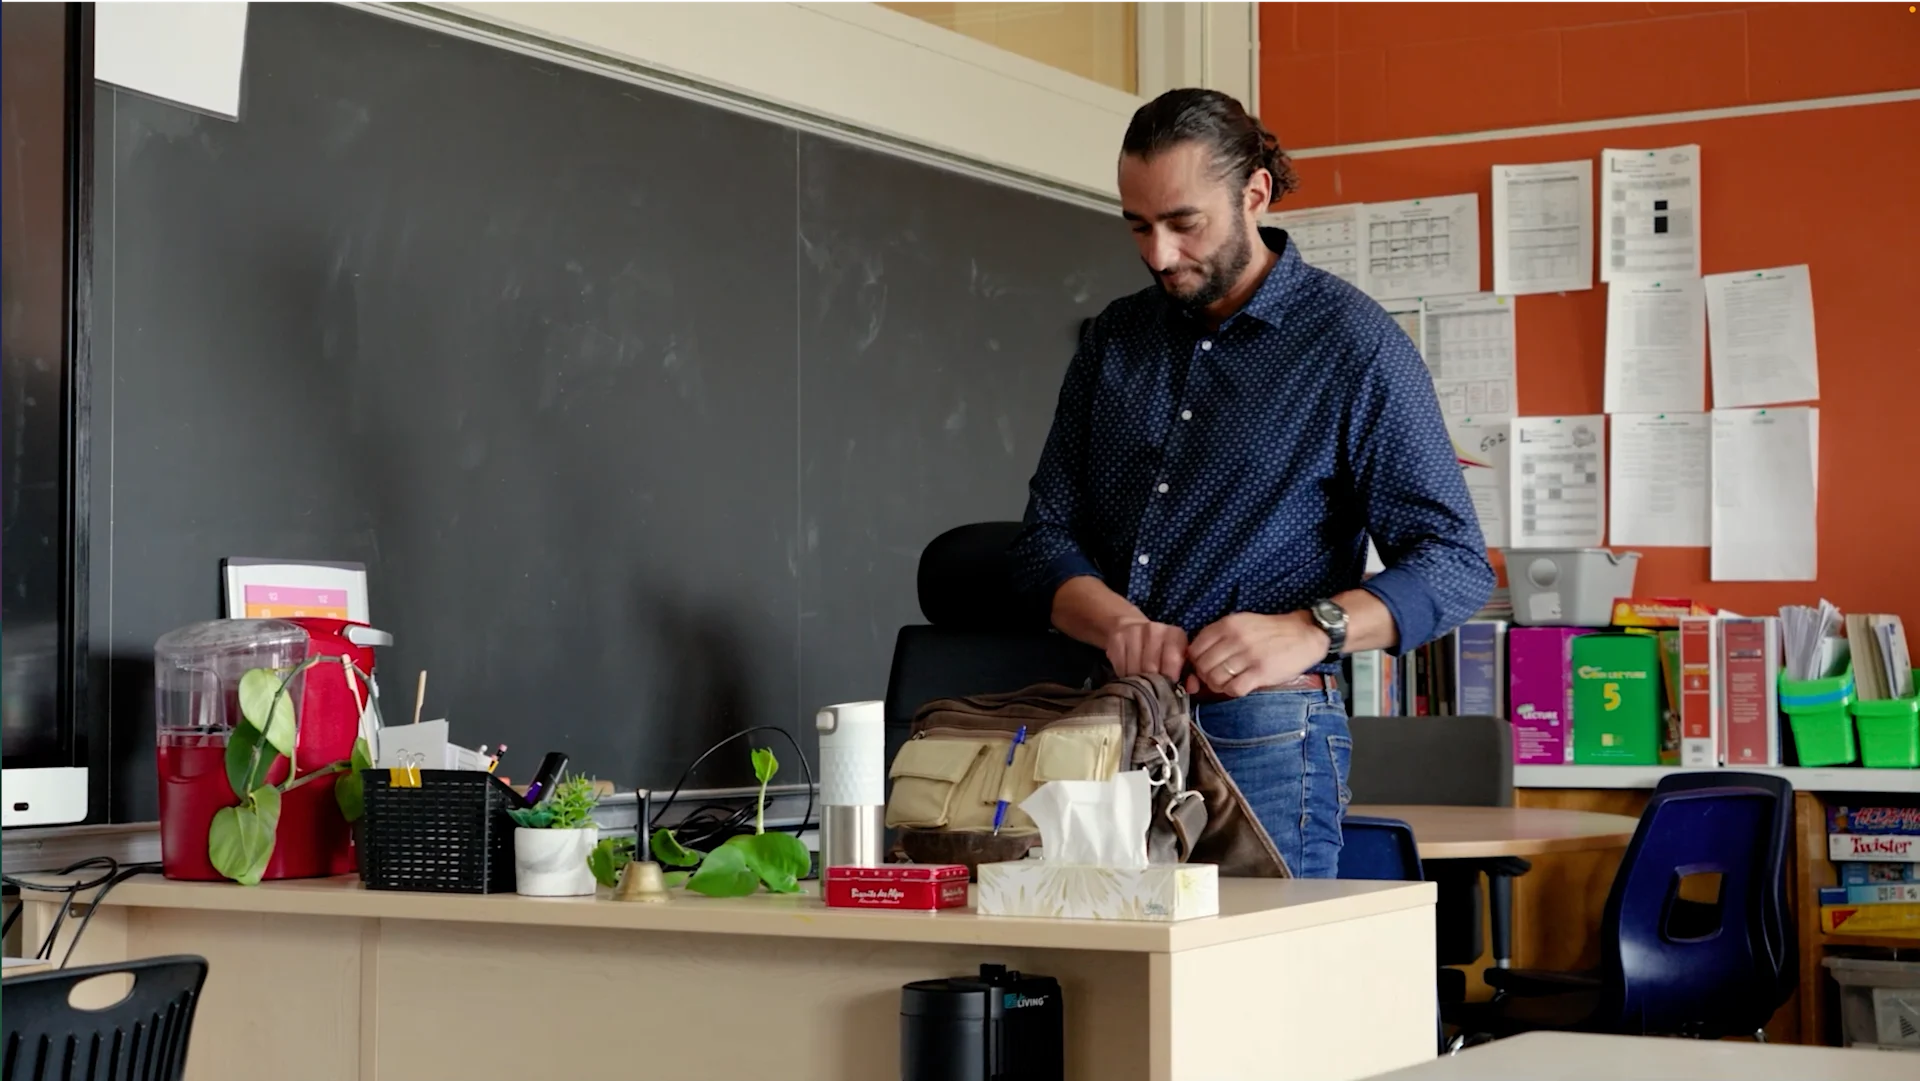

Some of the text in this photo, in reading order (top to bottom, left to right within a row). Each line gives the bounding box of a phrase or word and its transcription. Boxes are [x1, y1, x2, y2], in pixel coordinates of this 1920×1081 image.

[1480, 432, 1507, 452] 602
[1608, 671, 1647, 679] LECTURE
[1603, 682, 1621, 712] 5
[1850, 836, 1912, 853] Twister
[1017, 997, 1044, 1008] LIVING
